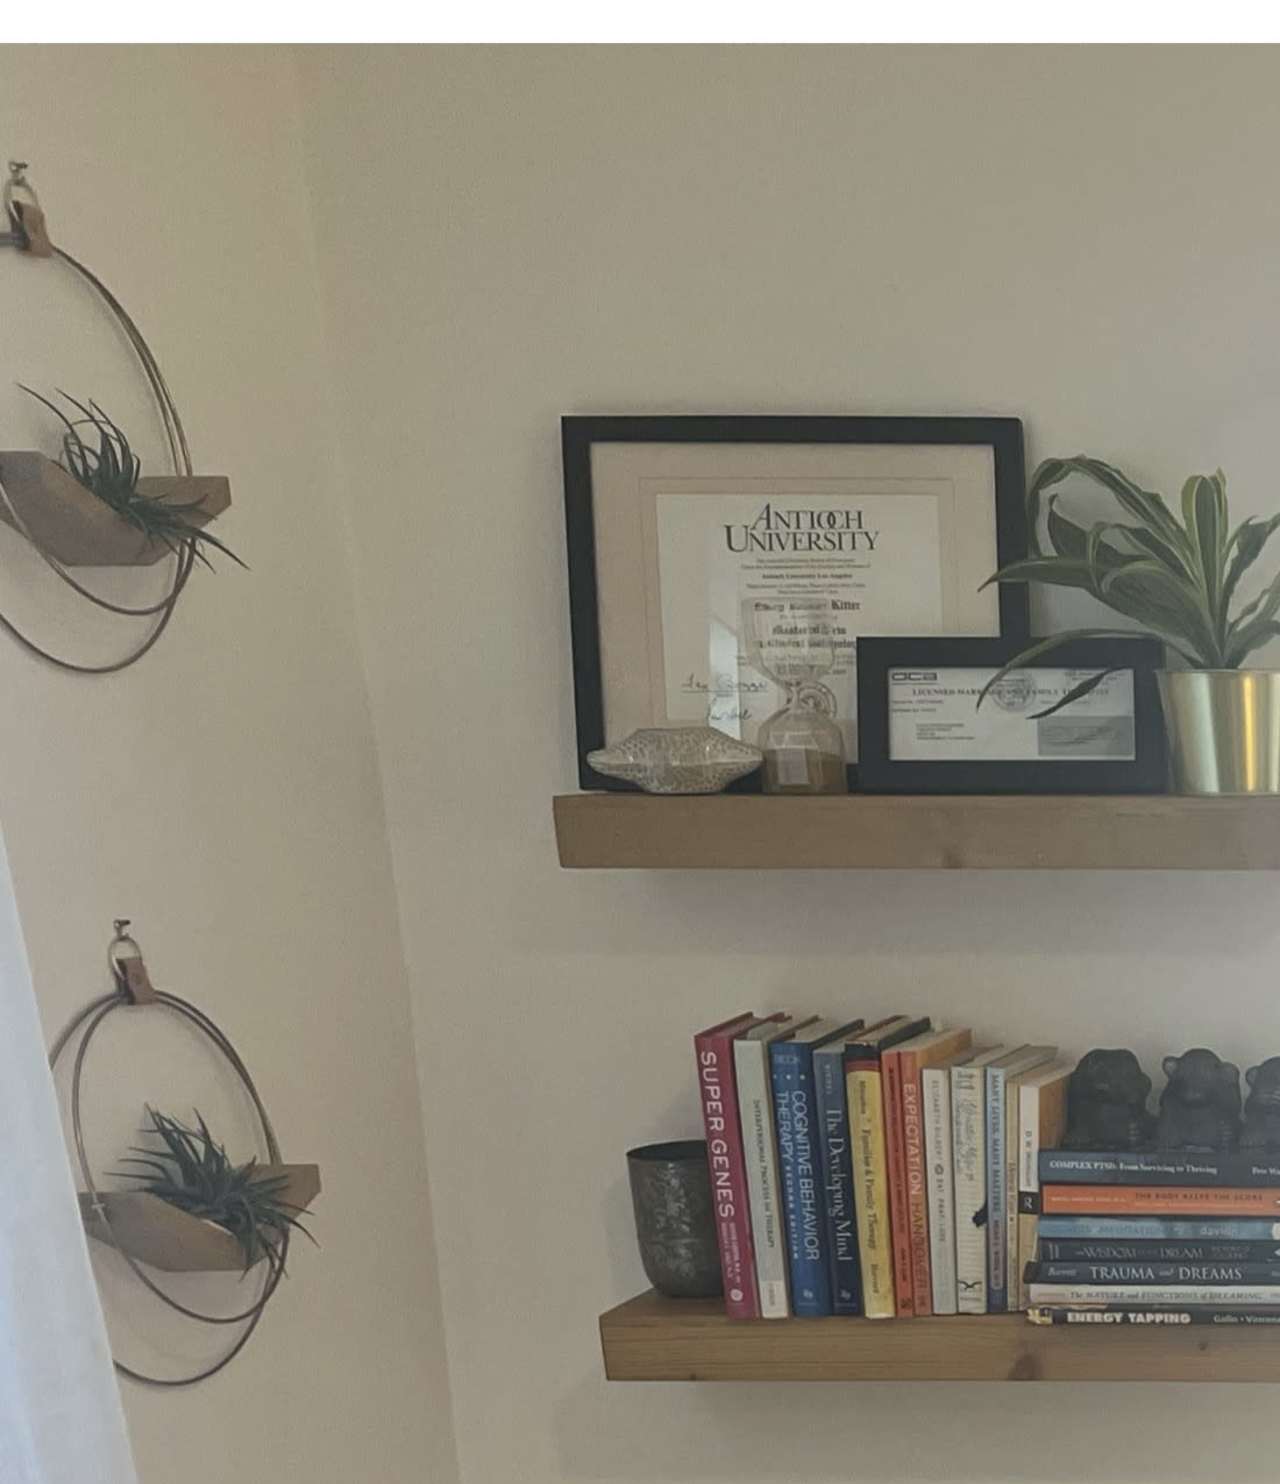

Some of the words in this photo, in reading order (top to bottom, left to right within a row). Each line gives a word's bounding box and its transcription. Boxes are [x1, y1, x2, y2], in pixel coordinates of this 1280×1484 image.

[750, 503, 864, 531] ANTIOCH
[724, 525, 879, 553] UNIVERSITY
[701, 1051, 725, 1132] SUPER
[776, 1091, 795, 1161] THERAPY
[791, 1090, 812, 1176] COGNITIVE
[826, 1108, 843, 1133] The
[903, 1083, 922, 1195] EXPECTATION
[711, 1139, 735, 1218] GENES
[826, 1137, 847, 1217] Developing
[1049, 1160, 1093, 1170] COMPLEX
[1118, 1162, 1139, 1171] From
[1139, 1162, 1175, 1175] Surviving
[1177, 1164, 1184, 1174] to
[1185, 1164, 1218, 1176] Thriving
[799, 1177, 820, 1261] BEHAVIOR
[835, 1219, 854, 1261] Mind
[911, 1202, 928, 1290] HANGOVER
[1159, 1247, 1203, 1259] DREAM
[1089, 1266, 1155, 1281] TRAUMA
[1178, 1265, 1243, 1281] DREAMS
[1070, 1291, 1082, 1300] The
[1085, 1291, 1126, 1300] NATURE
[1126, 1291, 1139, 1300] and
[1141, 1291, 1198, 1301] FUNCTIONS
[1208, 1291, 1263, 1301] DREAMING
[1066, 1312, 1123, 1323] ENERGY
[1128, 1312, 1192, 1324] TAPPING
[1213, 1315, 1238, 1323] Gallo
